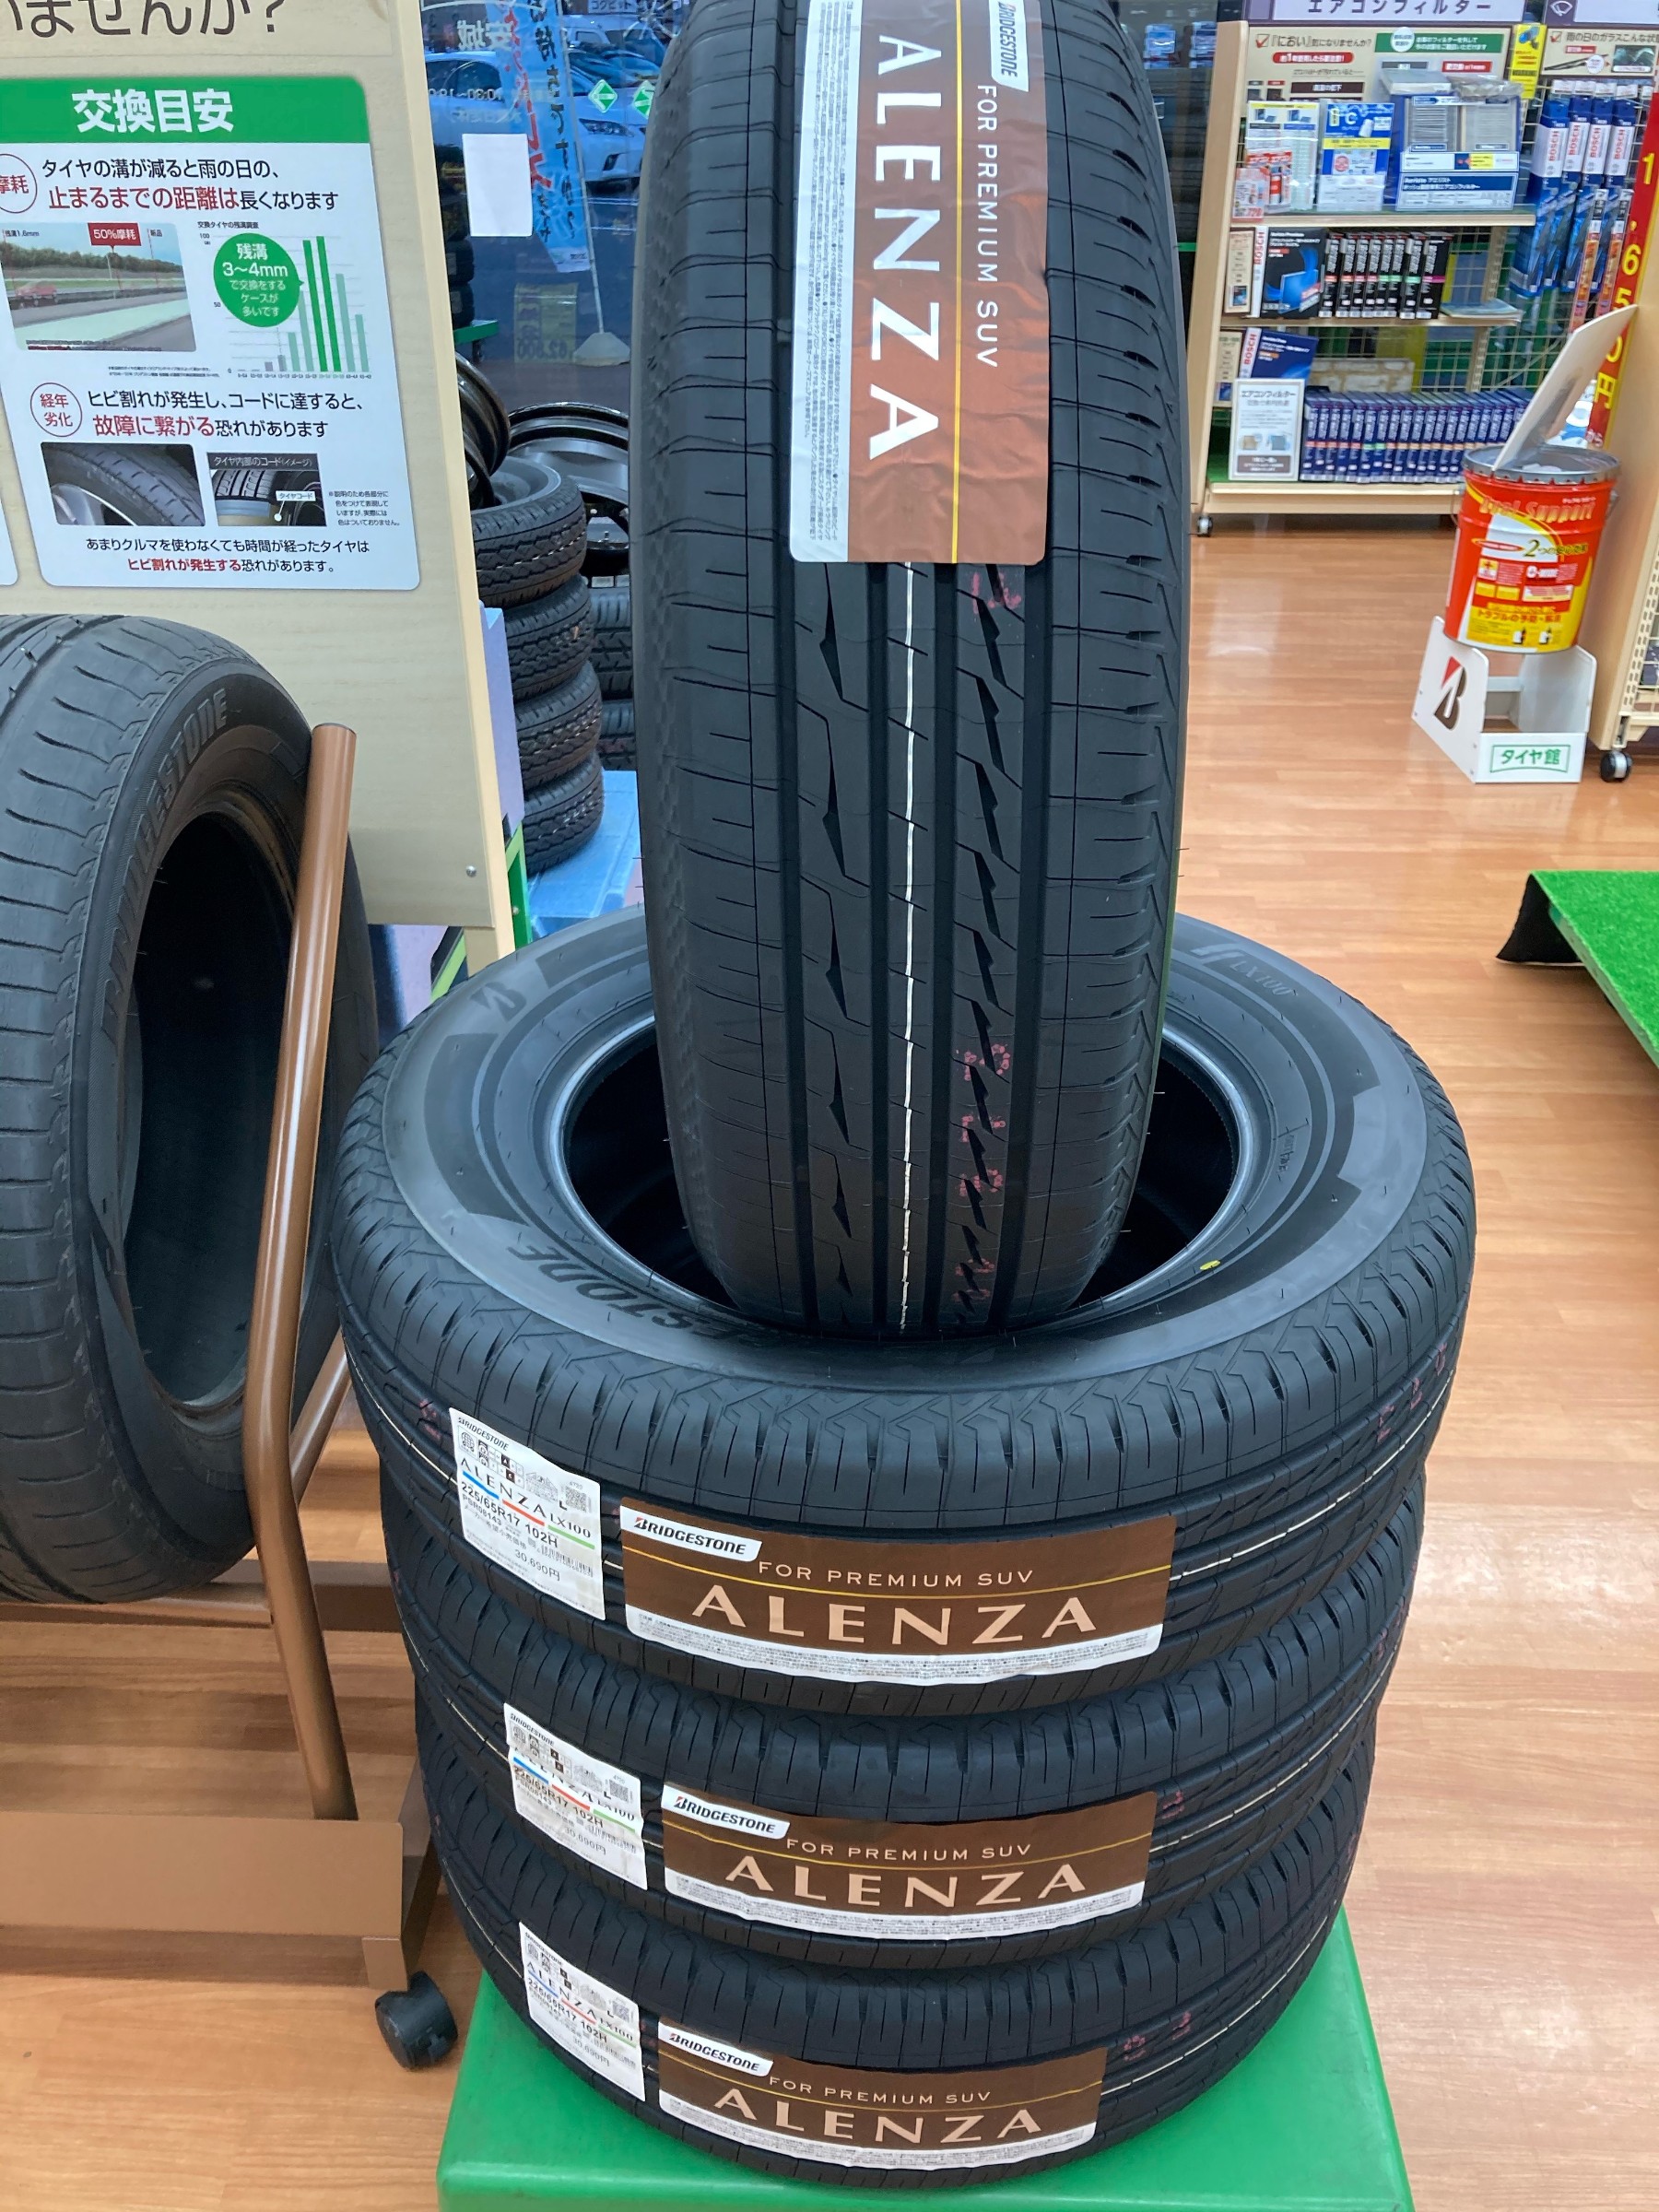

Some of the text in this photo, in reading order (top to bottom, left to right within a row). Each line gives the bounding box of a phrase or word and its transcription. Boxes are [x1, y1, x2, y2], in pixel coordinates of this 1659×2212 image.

[1308, 0, 1491, 15] エアコンフィルター
[997, 1, 1018, 78] BRIDGESTONE
[72, 89, 235, 134] 交換目安
[1548, 131, 1559, 162] BOSCH
[1568, 124, 1581, 156] BOSCH
[1589, 127, 1602, 159] BOSCH
[1614, 129, 1626, 159] BOSCH
[42, 159, 280, 180] タイヤの溝が減ると雨の日の、
[49, 186, 339, 211] 止まるまでの距離は長くなります
[93, 229, 137, 241] 50%摩耗
[976, 85, 998, 367] FOR PREMIUM SUV
[236, 242, 269, 261] 残溝
[869, 34, 942, 461] ALENZA
[229, 279, 287, 291] で交換をする
[241, 293, 279, 303] ケースが
[241, 306, 280, 317] 多いです
[1243, 333, 1257, 366] BOSCH
[40, 394, 68, 408] 経年
[88, 390, 363, 411] ヒビ割れが発生し、コードに達すると、
[44, 413, 74, 428] 劣化
[92, 415, 328, 438] 故障に繋がる恐れがあります
[278, 492, 313, 500] タイヤコード
[87, 538, 370, 553] あまりクルマを使わなくても時間が経ったタイヤは
[127, 558, 334, 573] ヒビ割れが発生する恐れがあります。
[1500, 748, 1560, 765] タイヤ館
[458, 1417, 509, 1451] BRIDGESTONE
[460, 1457, 591, 1539] ALENZA LX100
[462, 1480, 559, 1548] 225/65R17 102H
[633, 1515, 747, 1556] BRIDGESTONE
[759, 1560, 1034, 1588] FOR PREMIUM SUV
[691, 1584, 1097, 1646] ALENZA
[573, 1806, 604, 1829] 102H
[674, 1794, 776, 1835] BRIDGESTONE
[786, 1839, 1031, 1861] FOR PREMIUM SUV
[725, 1854, 1087, 1908] ALENZA
[581, 2020, 607, 2043] 102H
[669, 2032, 760, 2072] BRIDGESTONE
[769, 2076, 991, 2105] FOR PREMIUM SUV
[714, 2088, 1042, 2144] ALENZA
